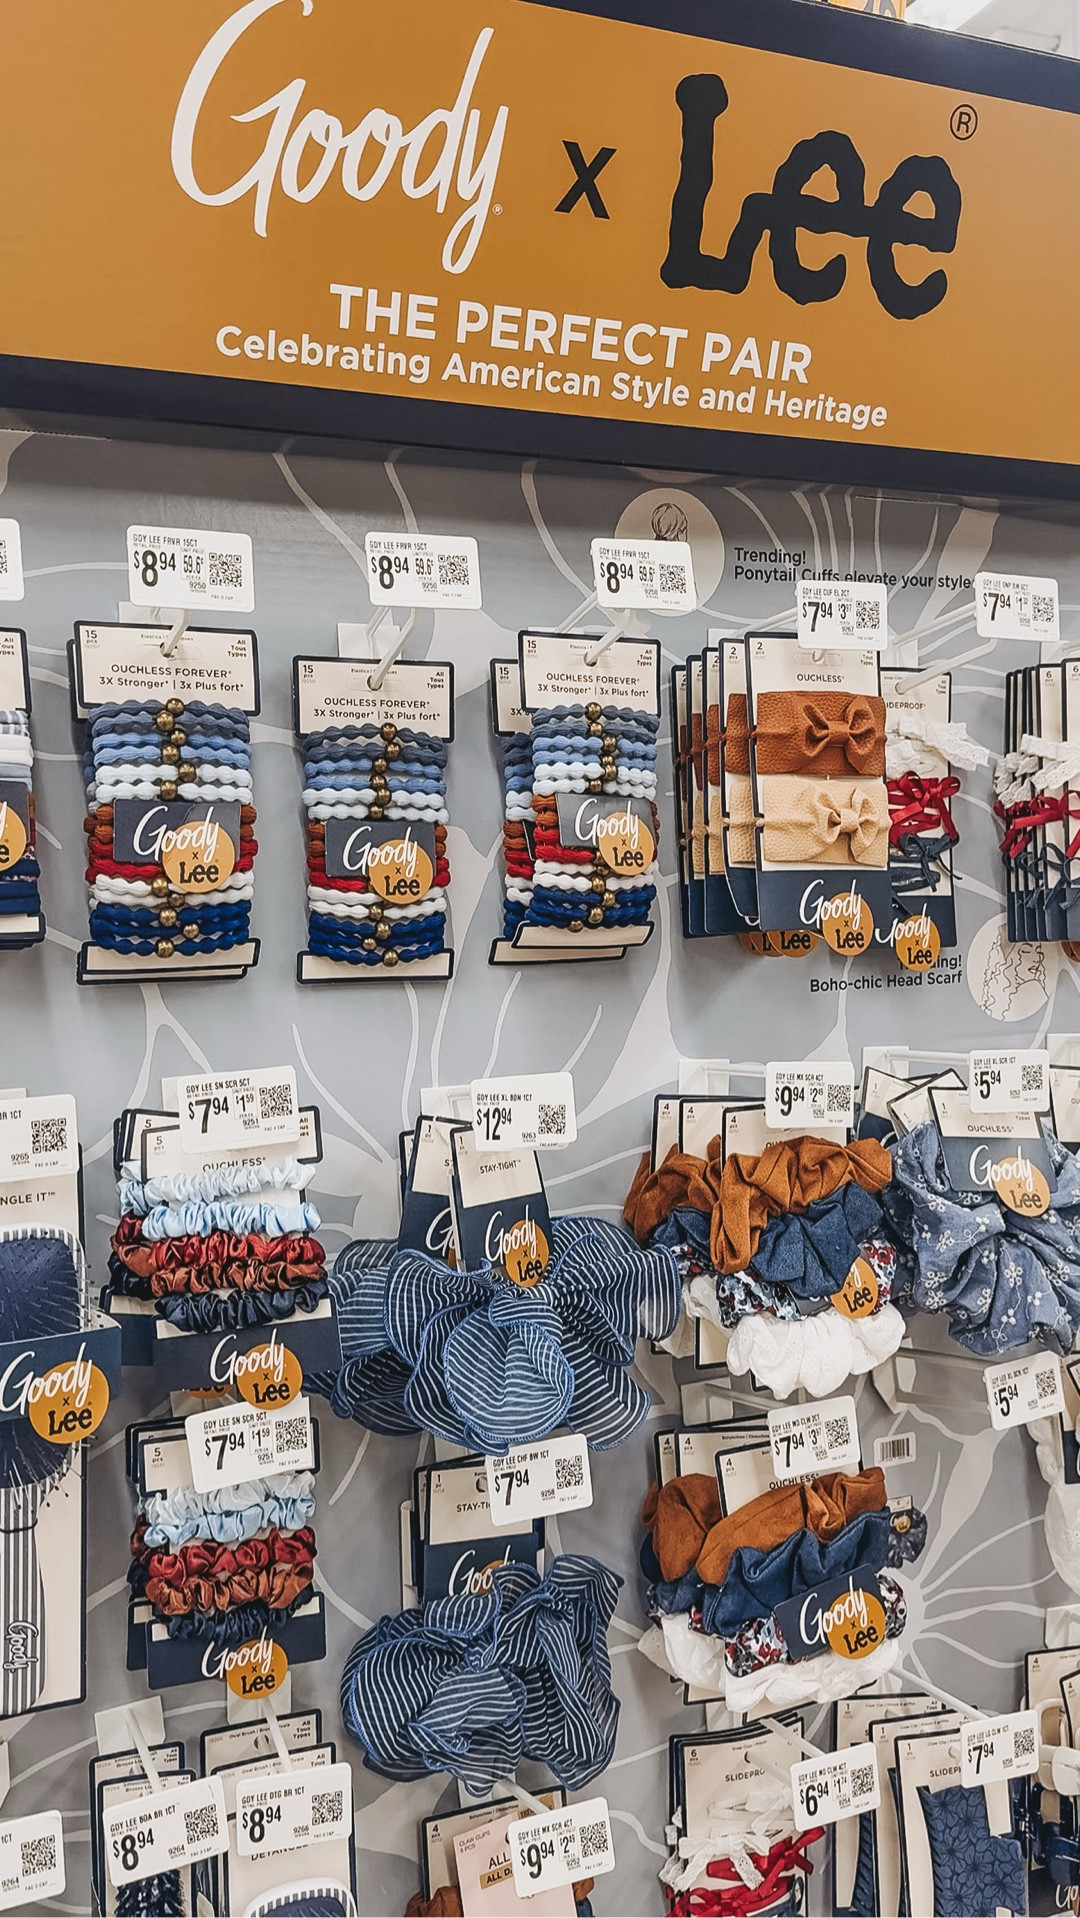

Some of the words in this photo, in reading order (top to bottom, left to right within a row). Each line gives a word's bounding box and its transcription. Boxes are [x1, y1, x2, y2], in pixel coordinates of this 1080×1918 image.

[171, 0, 510, 274] Goody
[660, 73, 962, 320] Lee
[329, 283, 438, 340] THE
[456, 300, 689, 369] PERFECT
[701, 331, 812, 384] PAIR
[215, 325, 431, 384] Celebrating
[441, 352, 600, 398] American
[610, 371, 690, 410] Style
[699, 386, 756, 414] and
[764, 388, 888, 431] Heritage
[149, 536, 160, 544] LEE
[183, 538, 197, 547] 15CT
[734, 548, 806, 566] Trending!
[734, 566, 796, 583] Ponytail
[802, 569, 839, 581] Cuffs
[845, 571, 896, 586] elevate
[902, 574, 933, 588] your
[85, 630, 97, 638] 15
[527, 640, 536, 648] 15
[111, 665, 172, 675] OUCHLESS
[303, 665, 313, 673] 15
[547, 673, 593, 682] OUCHLESS
[797, 674, 842, 683] OUCHLESS
[100, 677, 113, 685] 3X
[180, 682, 192, 690] 3x
[196, 682, 217, 691] Plus
[324, 698, 376, 707] OUCHLESS
[575, 798, 638, 849] Goody
[133, 806, 219, 863] Goody
[343, 826, 418, 878] Goody
[612, 847, 644, 867] Lee
[179, 861, 219, 883] Lee
[384, 875, 420, 896] Lee
[800, 879, 862, 930] Goody
[781, 931, 810, 949] Lee
[835, 929, 865, 949] Lee
[907, 947, 932, 965] Lee
[810, 973, 882, 992] Boho-chic
[887, 975, 922, 987] Head
[927, 972, 962, 984] Scarf
[215, 1082, 223, 1090] SN
[225, 1080, 238, 1088] SCR
[239, 1078, 250, 1086] 5CT
[11, 1153, 29, 1161] 9265
[969, 1145, 1032, 1192] Goody
[1010, 1190, 1042, 1208] Lee
[485, 1204, 536, 1264] Goody
[517, 1259, 542, 1282] Lee
[843, 1287, 873, 1313] Lee
[210, 1328, 284, 1384] Goody
[0, 1342, 92, 1415] Goody
[253, 1382, 290, 1404] Lee
[48, 1408, 92, 1436] Lee
[219, 1419, 230, 1427] LEE
[243, 1415, 254, 1423] SCR
[256, 1412, 266, 1420] 5CT
[154, 1448, 161, 1456] 5
[518, 1455, 528, 1463] CHF
[540, 1450, 549, 1458] 1CT
[800, 1575, 867, 1644] Goody
[3, 1621, 39, 1670] Goody
[843, 1626, 878, 1654] Lee
[202, 1625, 273, 1678] Goody
[241, 1674, 275, 1694] Lee
[257, 1793, 267, 1801] LEE
[270, 1790, 281, 1798] DTG
[284, 1789, 292, 1797] BR
[295, 1786, 305, 1795] 1CT
[126, 1817, 137, 1828] LEE
[139, 1814, 152, 1824] BOA
[154, 1809, 163, 1818] BR
[166, 1805, 176, 1816] 1CT
[2, 1833, 12, 1844] 1CT
[293, 1825, 309, 1834] 9266
[459, 1836, 474, 1847] CLAW
[476, 1830, 490, 1840] CLIPS
[168, 1845, 185, 1856] 9264
[488, 1852, 510, 1869] ALL
[2, 1876, 19, 1888] 9264
[486, 1871, 502, 1884] ALL
